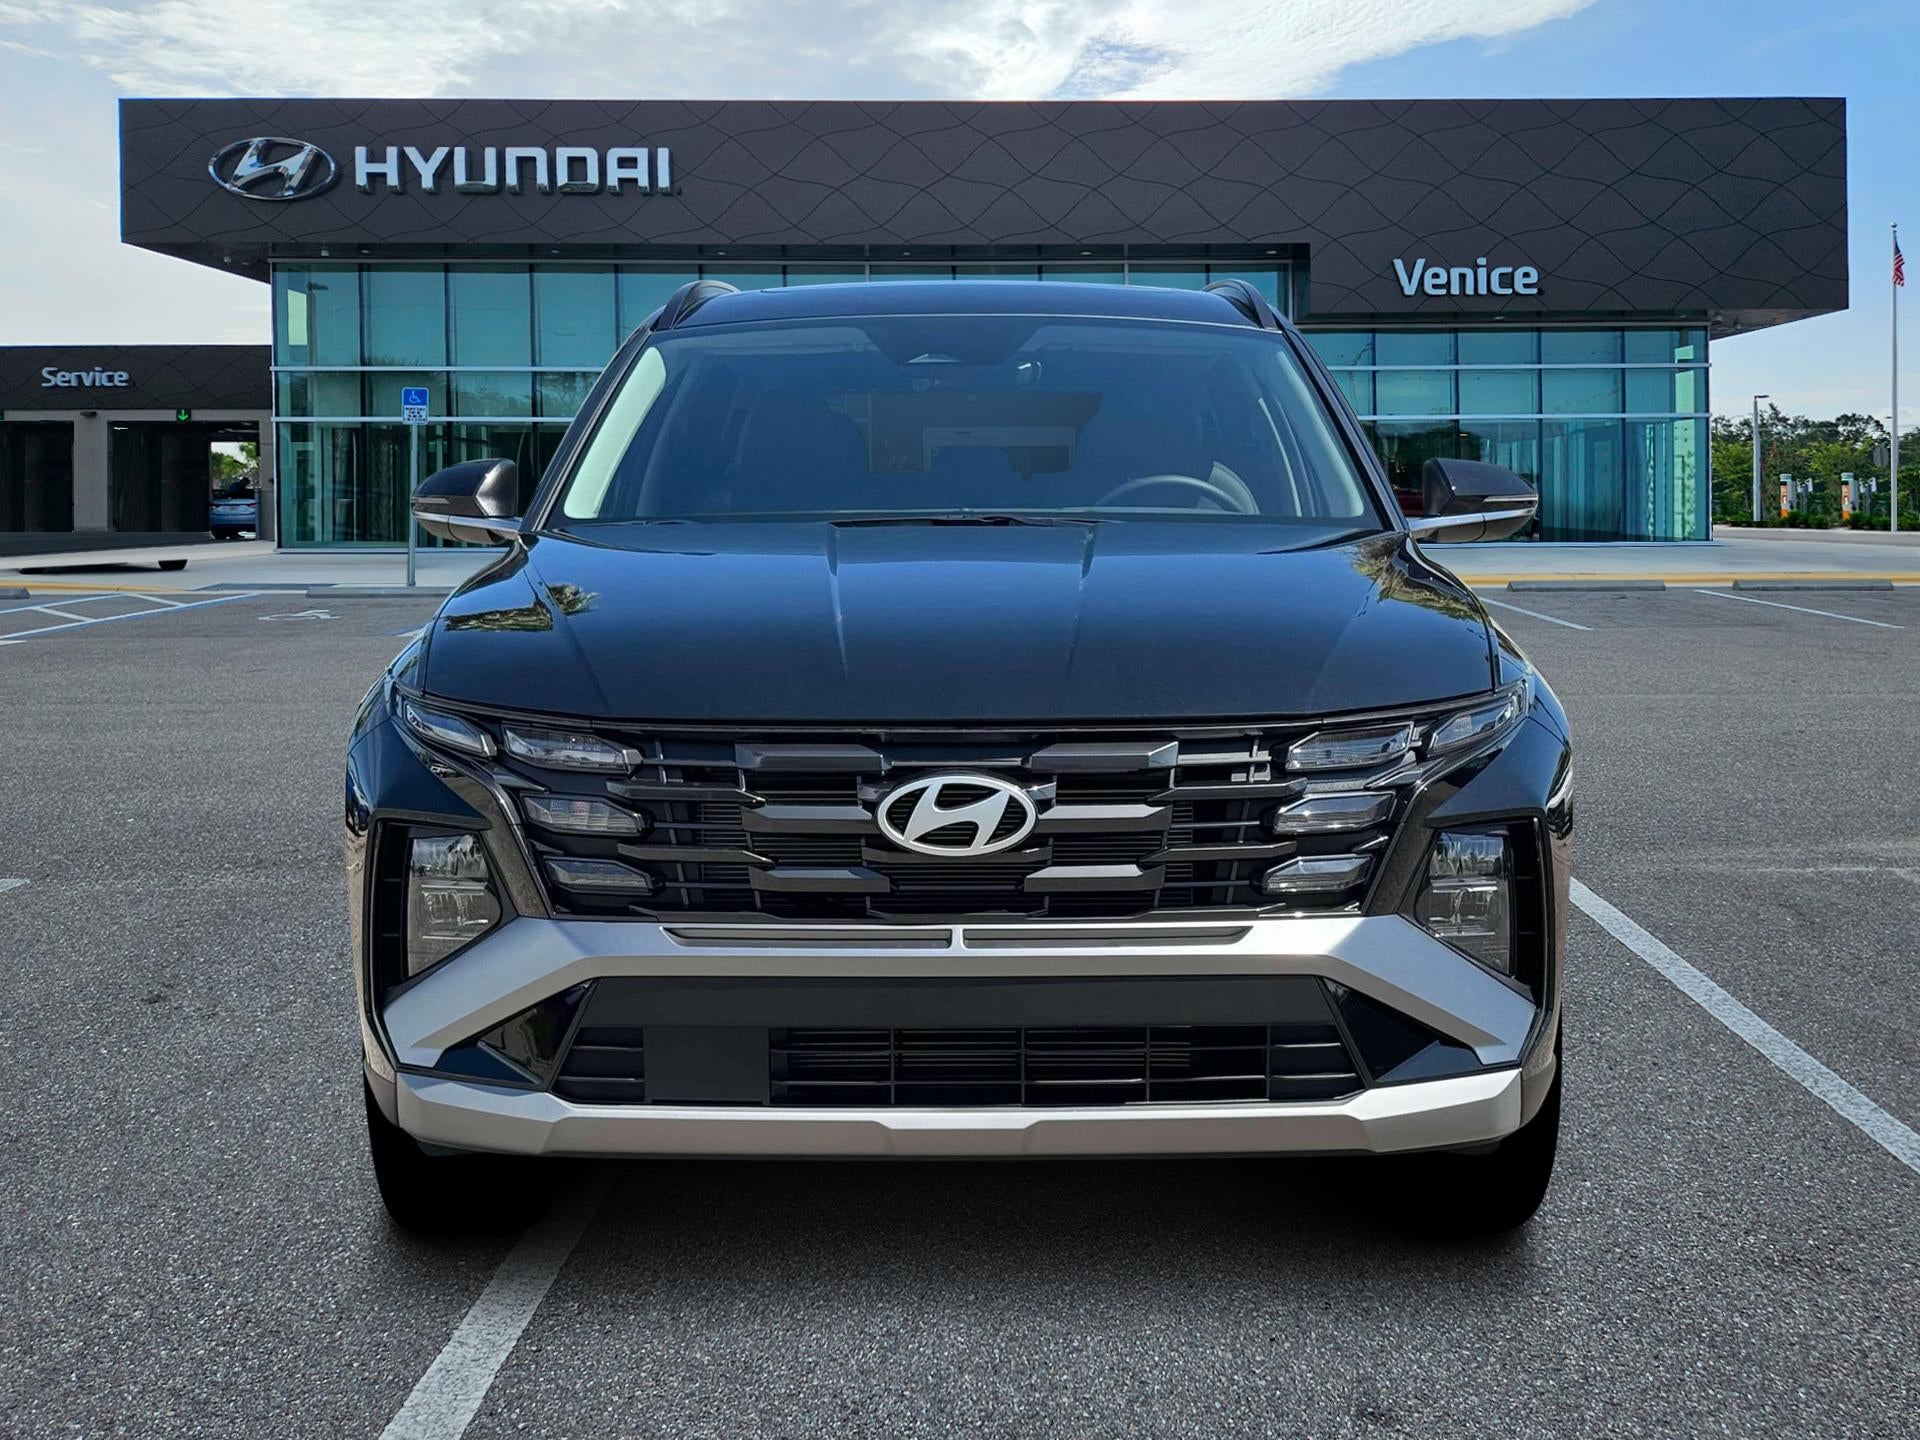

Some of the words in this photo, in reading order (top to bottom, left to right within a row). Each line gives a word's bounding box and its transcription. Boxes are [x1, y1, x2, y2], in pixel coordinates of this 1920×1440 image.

[355, 146, 670, 193] HYUNDAI
[1393, 257, 1539, 296] Venice
[41, 366, 129, 387] Service
